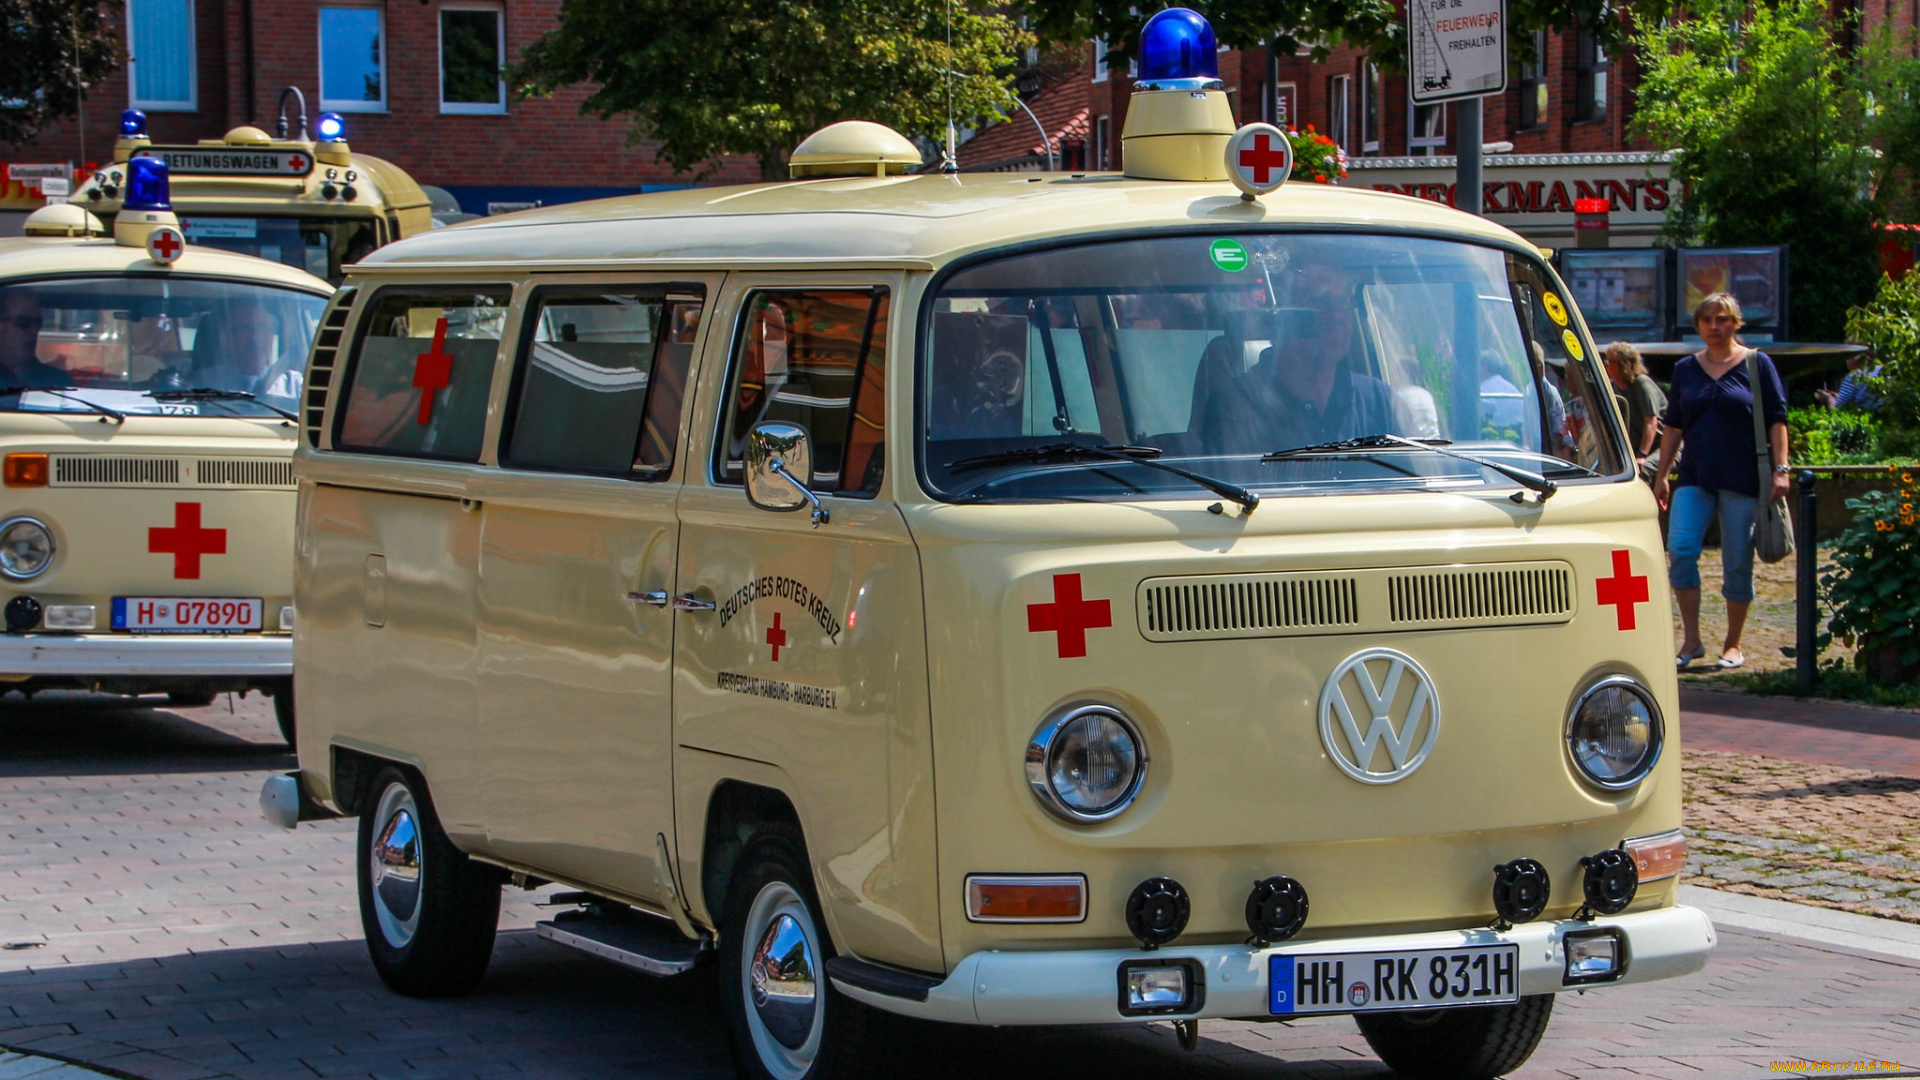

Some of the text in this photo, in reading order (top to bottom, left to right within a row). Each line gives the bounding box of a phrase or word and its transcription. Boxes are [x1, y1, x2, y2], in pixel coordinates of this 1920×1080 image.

[1436, 12, 1499, 33] FEUERWEHR
[1449, 36, 1496, 51] FREIHALTEN
[163, 154, 279, 169] RETTUNGSWAGEN
[138, 602, 252, 625] H 07890
[720, 576, 841, 645] DEUTSCHES ROTES KREUZ
[717, 671, 759, 696] KREISVERBAND
[825, 689, 838, 710] E.V.
[1297, 952, 1514, 1005] HH RK 831H
[1277, 991, 1287, 1003] D
